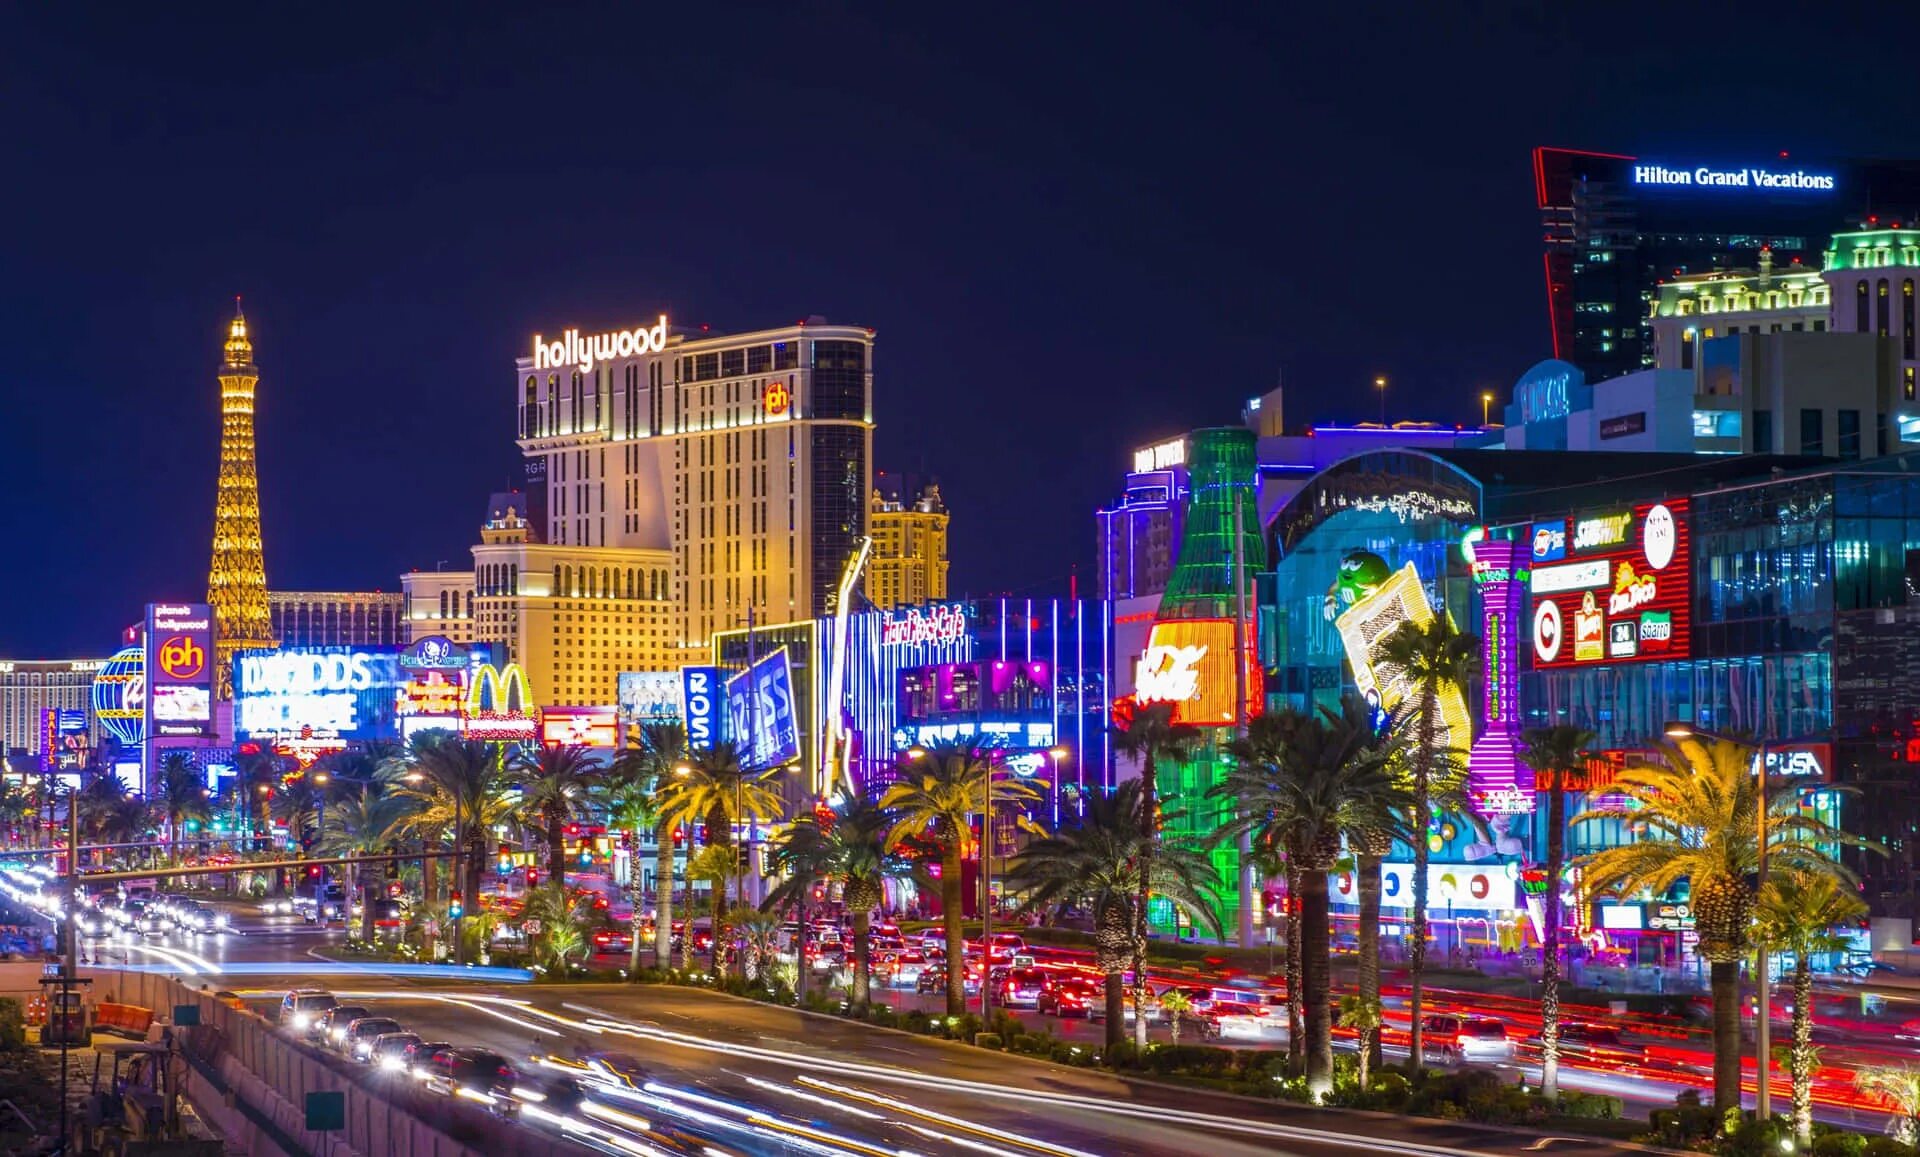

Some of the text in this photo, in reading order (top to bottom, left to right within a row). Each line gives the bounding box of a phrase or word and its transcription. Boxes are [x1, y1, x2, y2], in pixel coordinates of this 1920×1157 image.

[1634, 166, 1835, 190] Hilton Grand Vacations
[533, 313, 667, 374] hollywood
[1573, 512, 1632, 550] SUBWAY
[155, 604, 192, 618] planet
[155, 618, 209, 632] hollywood
[1615, 624, 1631, 642] 24
[1641, 619, 1670, 640] sbarro
